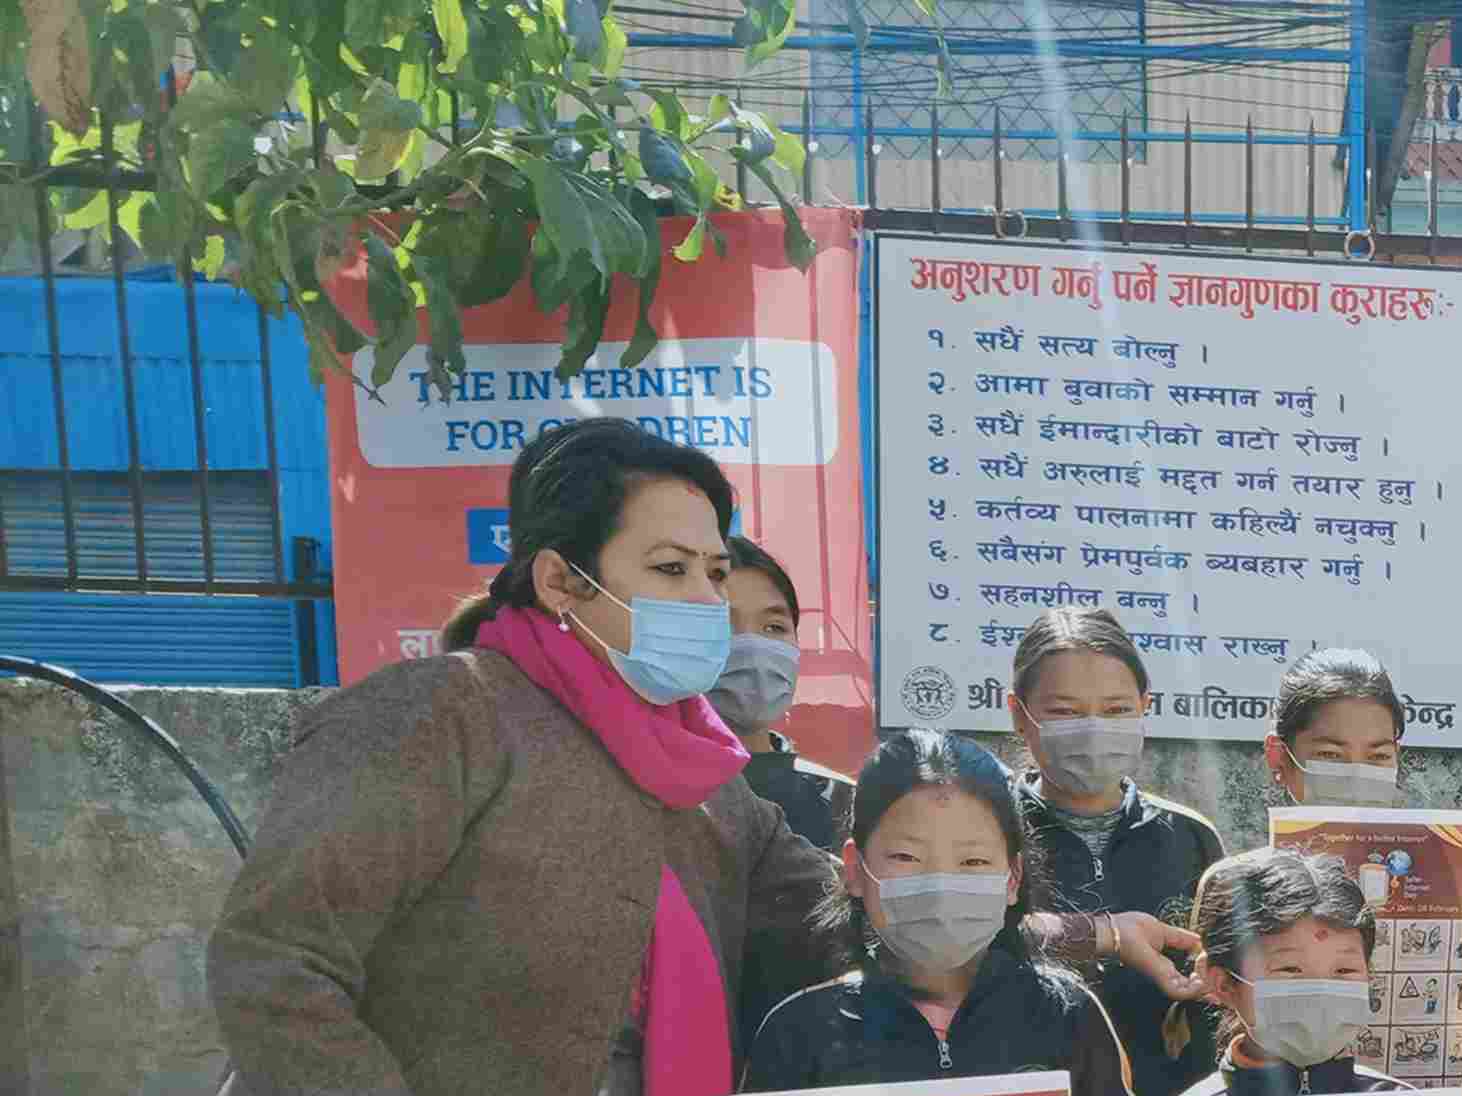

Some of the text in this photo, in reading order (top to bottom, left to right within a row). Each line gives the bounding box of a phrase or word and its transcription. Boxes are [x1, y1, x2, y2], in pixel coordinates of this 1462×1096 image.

[910, 256, 1041, 303] अनुशरण
[1112, 261, 1159, 305] पर्ने
[1167, 274, 1321, 319] ज्ञानगुणका
[1038, 335, 1099, 357] सत्य
[409, 366, 773, 405] THE INTERNET IS
[975, 373, 1049, 397] आमा
[1168, 384, 1261, 409] सम्मान
[1272, 386, 1318, 418] गर्नु
[445, 419, 525, 453] FOR
[1216, 426, 1280, 451] बाटो
[1234, 466, 1279, 492] गर्न
[1290, 474, 1366, 500] तयार
[1376, 478, 1416, 505] हुनु
[1074, 504, 1198, 529] पालनामा
[1320, 553, 1364, 585] गर्नु
